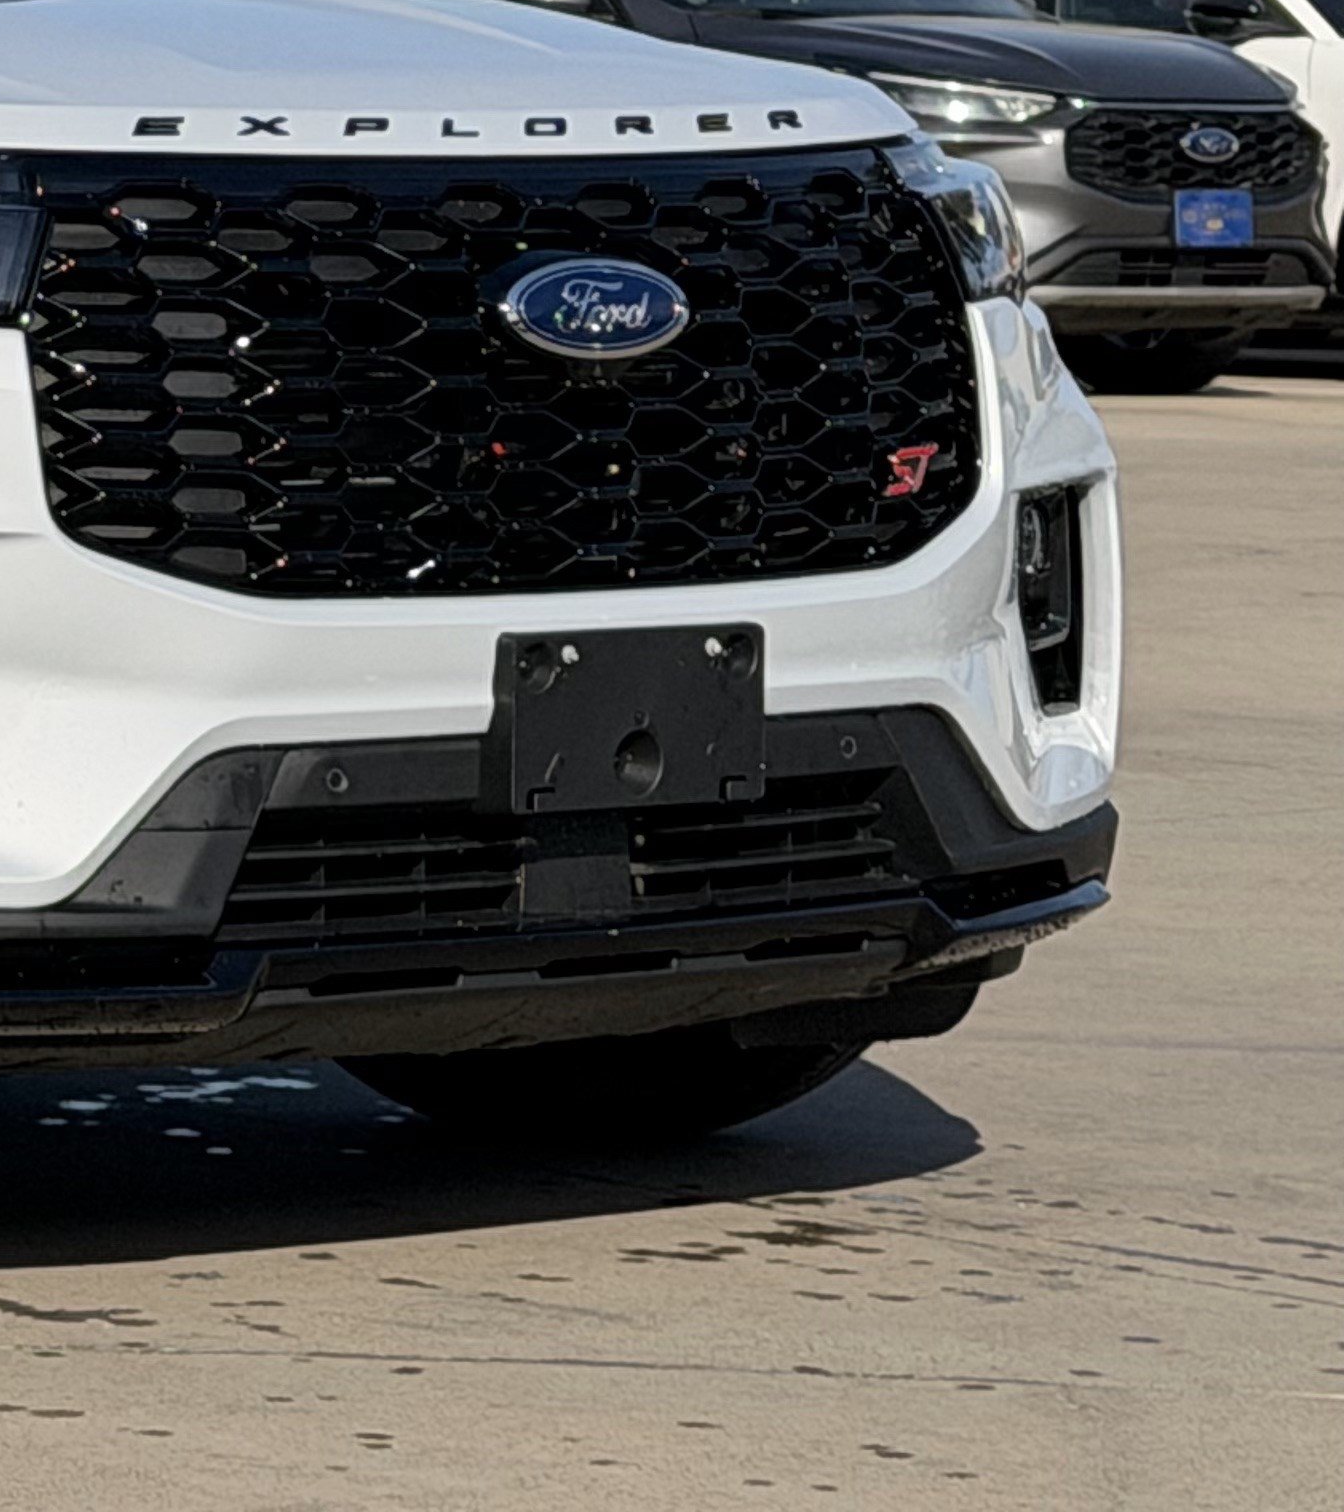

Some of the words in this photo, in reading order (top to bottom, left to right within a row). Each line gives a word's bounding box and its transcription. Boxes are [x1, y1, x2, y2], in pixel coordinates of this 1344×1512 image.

[131, 108, 803, 138] EXPLORER
[555, 279, 653, 334] Ford
[880, 442, 940, 498] ST
